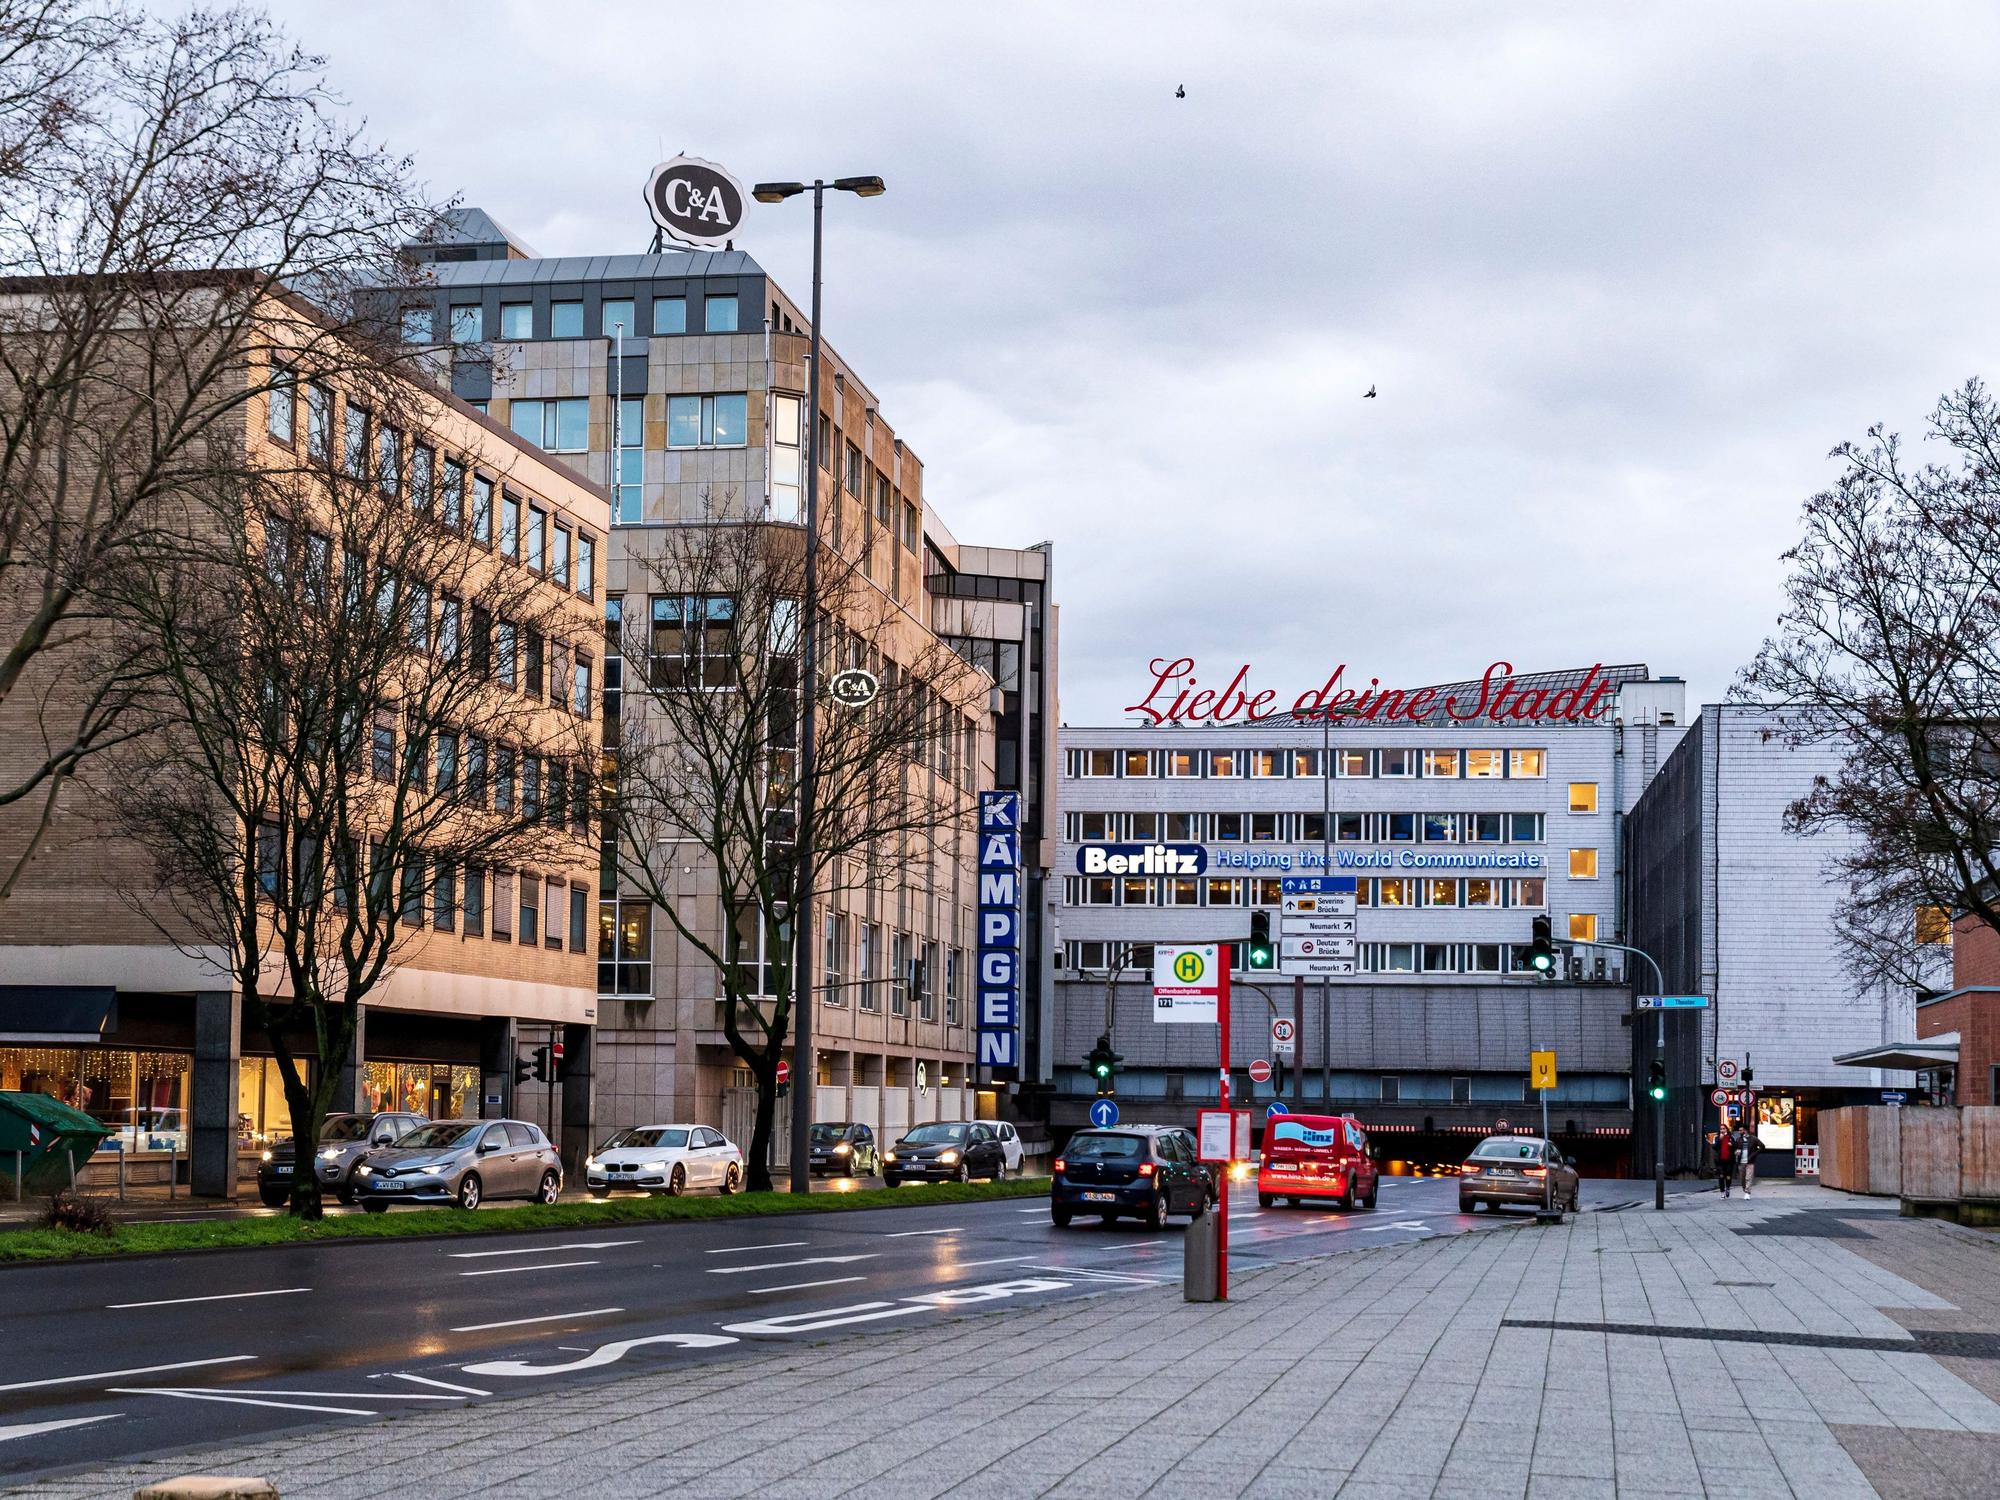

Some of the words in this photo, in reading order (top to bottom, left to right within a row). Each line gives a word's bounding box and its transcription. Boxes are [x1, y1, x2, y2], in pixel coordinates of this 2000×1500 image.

[665, 178, 731, 226] C&A
[838, 679, 871, 697] C&A
[1124, 658, 1277, 725] Liebe
[1292, 664, 1437, 721] deine
[1445, 661, 1614, 721] Stadt
[1085, 844, 1199, 875] Berlitz
[1216, 850, 1292, 870] Helping
[1300, 850, 1330, 867] the
[1337, 850, 1393, 867] World
[1399, 850, 1540, 868] Communicate
[1317, 897, 1345, 905] Severins-
[1317, 905, 1339, 913] Brücke
[1309, 922, 1340, 930] Neumarkt
[1318, 947, 1340, 955] Brücke
[1182, 958, 1196, 976] H
[1309, 964, 1340, 972] Heumarkt
[1158, 999, 1172, 1007] 171
[1540, 1065, 1548, 1075] U
